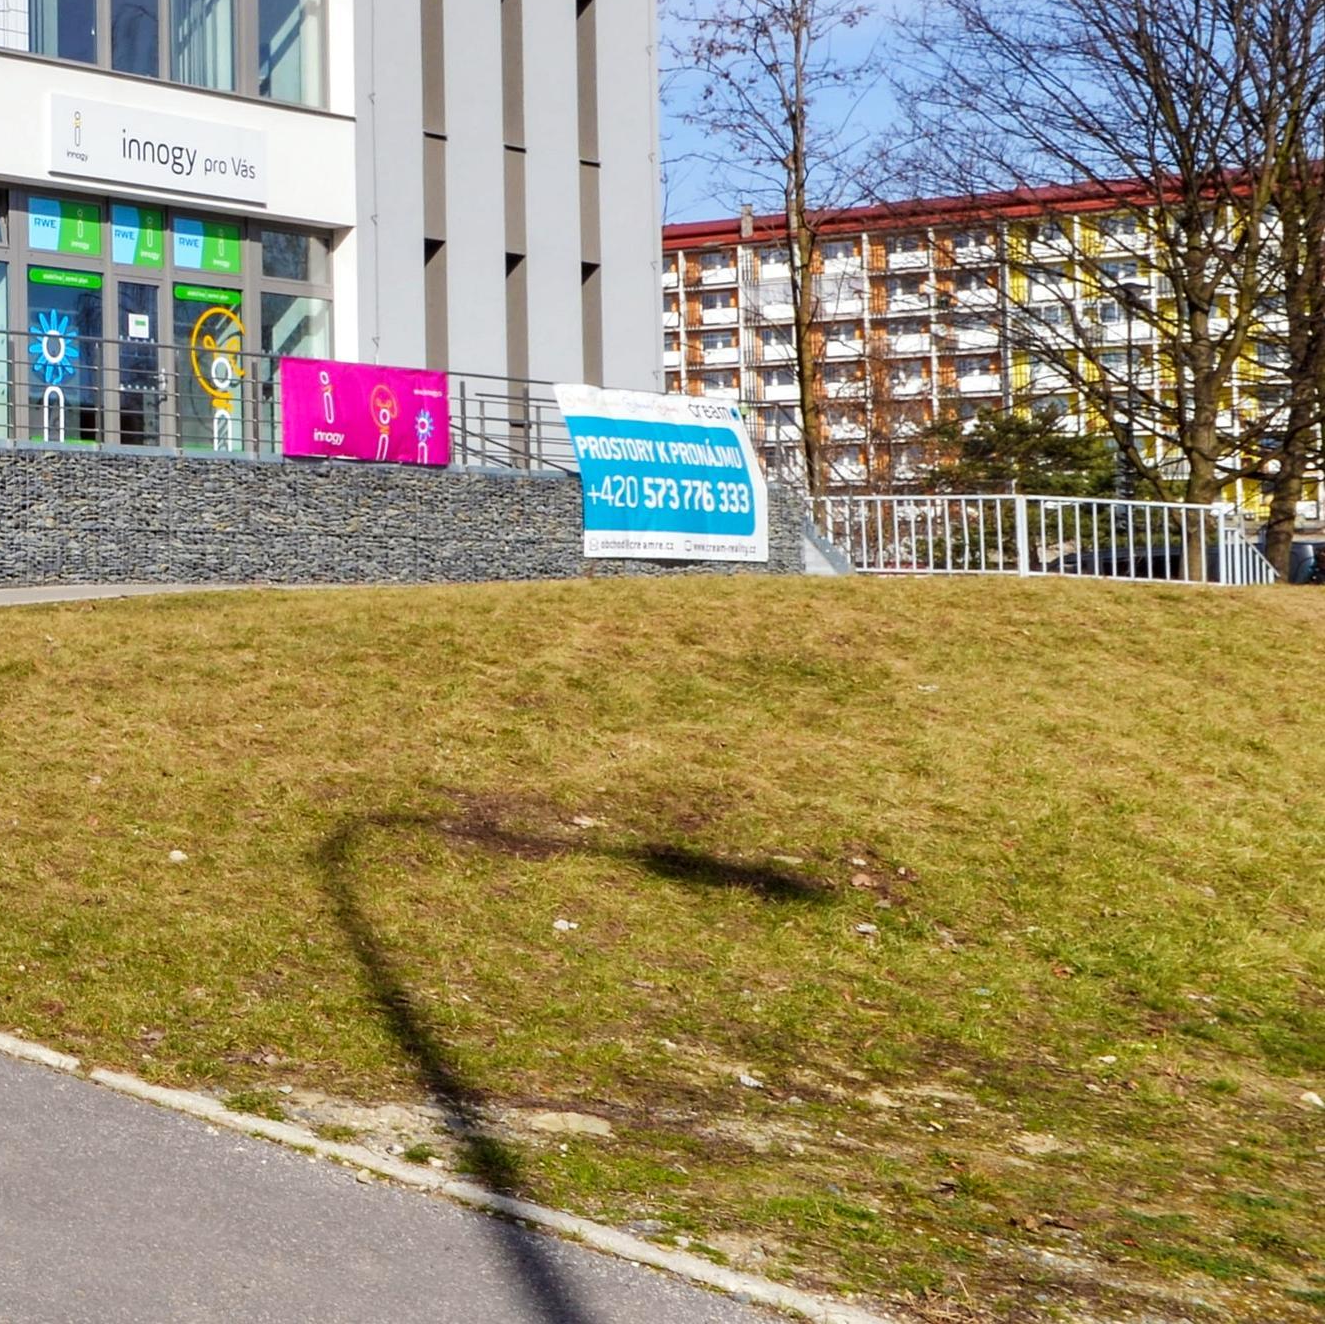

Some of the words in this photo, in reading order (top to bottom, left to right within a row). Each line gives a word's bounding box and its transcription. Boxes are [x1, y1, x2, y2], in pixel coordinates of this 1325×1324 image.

[122, 128, 197, 176] innogy
[204, 157, 228, 176] pro
[231, 156, 257, 179] Vás
[33, 217, 57, 229] RWE
[114, 229, 135, 240] RWE
[178, 237, 200, 248] RWE
[575, 436, 656, 462] PROSTORY
[656, 440, 670, 463] K
[669, 438, 743, 469] PRONÁJMU
[587, 475, 638, 508] +420
[643, 477, 680, 510] 573
[680, 479, 715, 512] 776
[717, 481, 750, 514] 333
